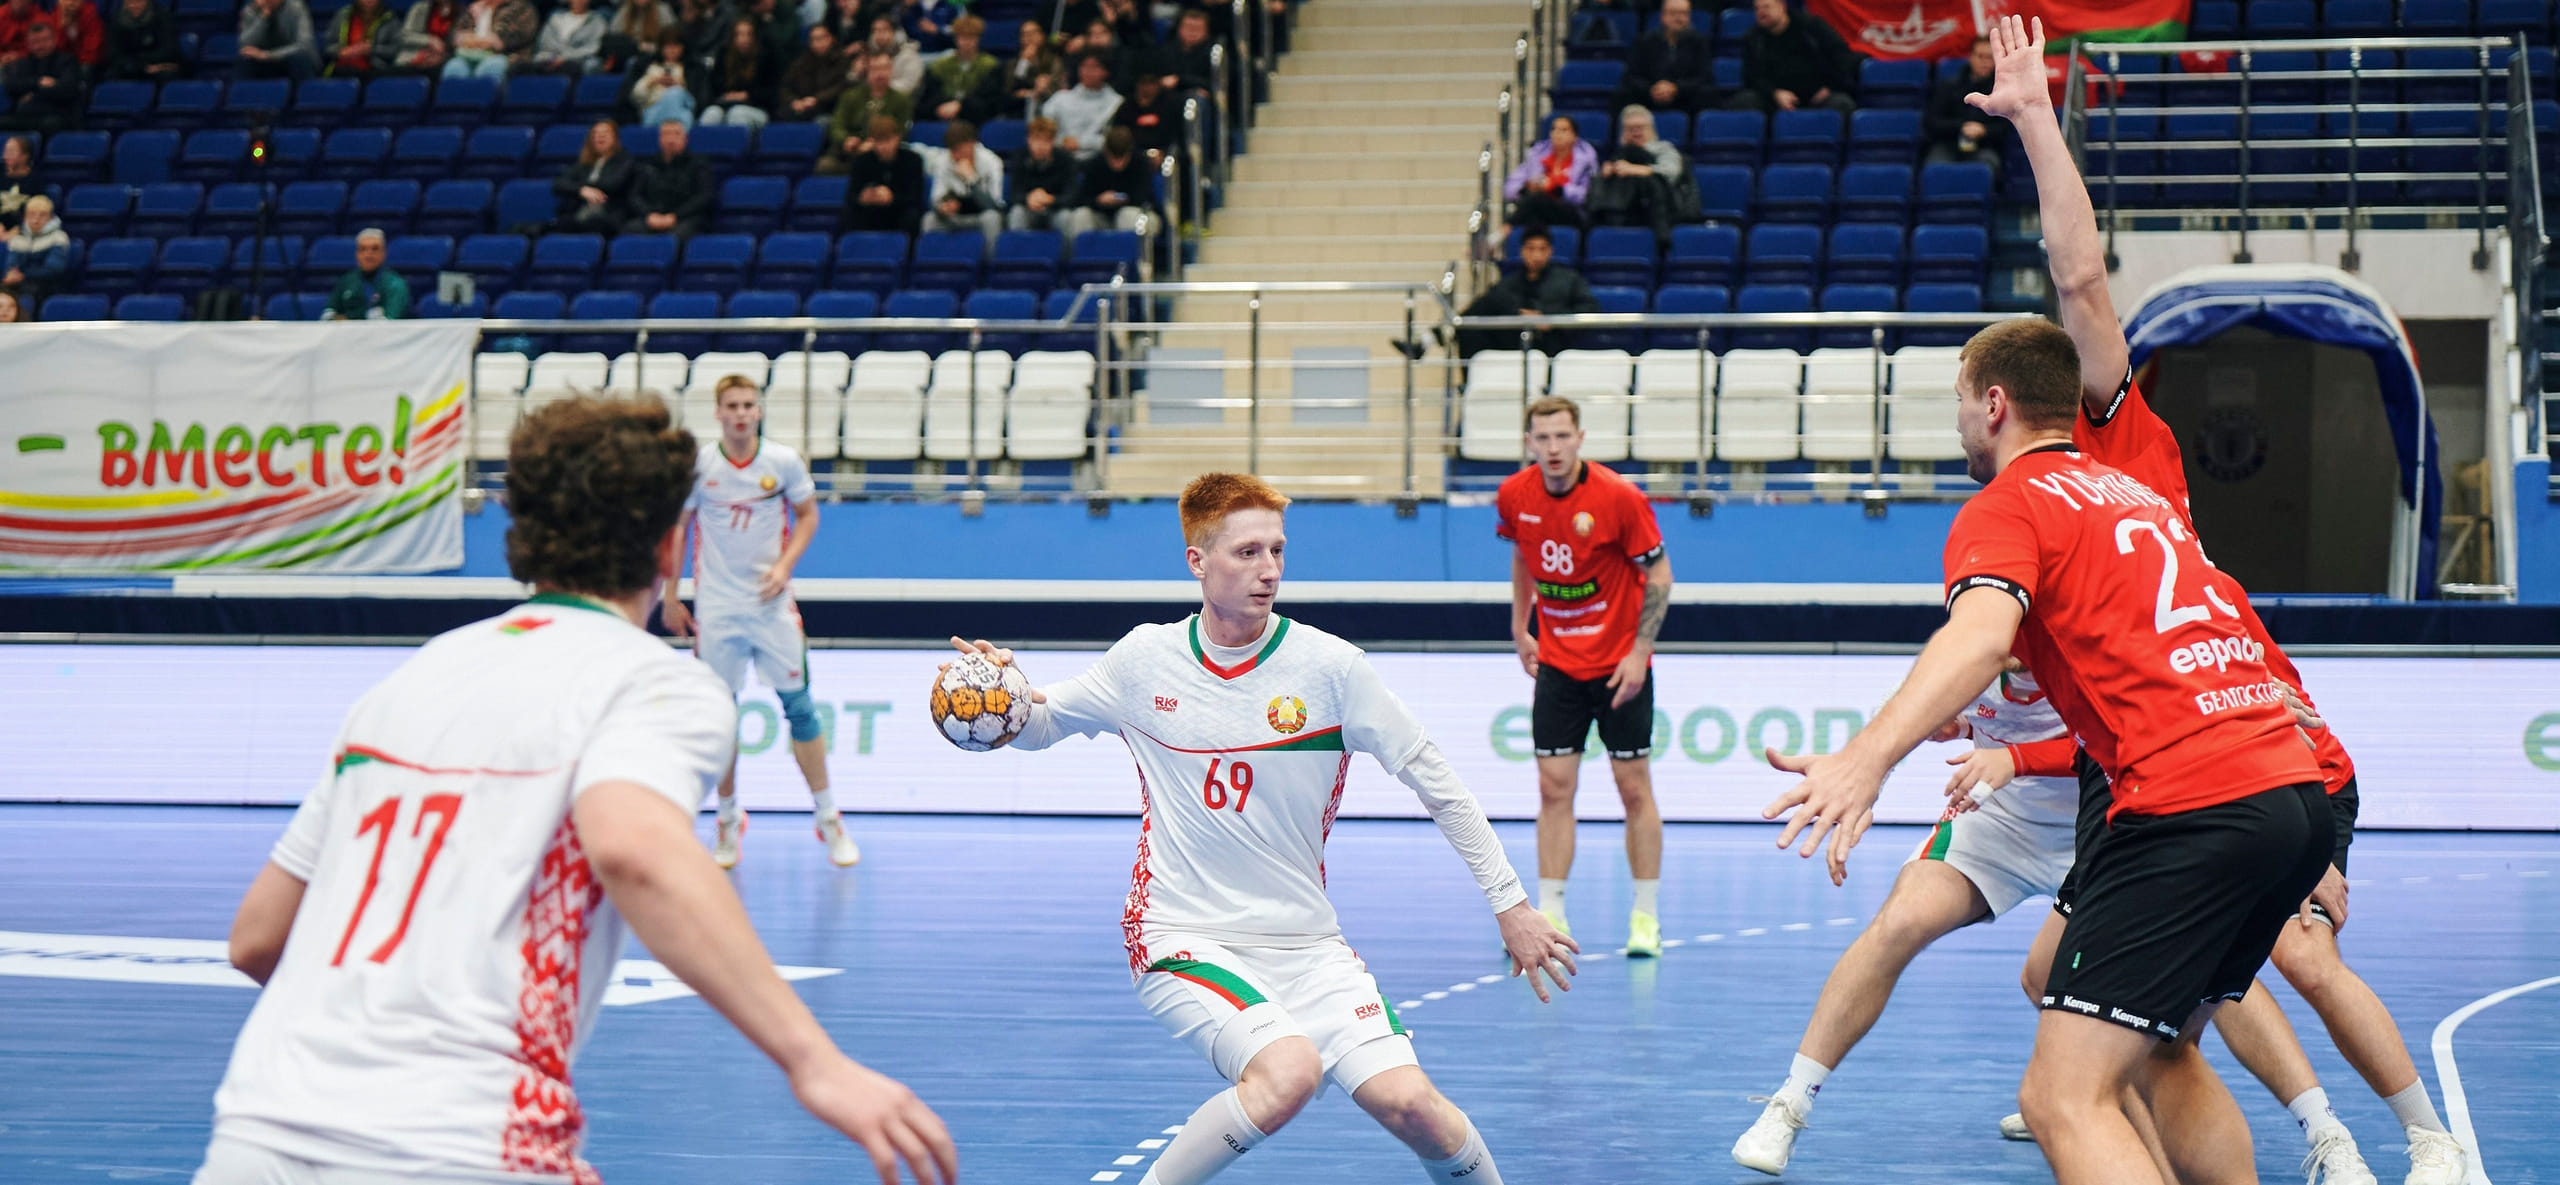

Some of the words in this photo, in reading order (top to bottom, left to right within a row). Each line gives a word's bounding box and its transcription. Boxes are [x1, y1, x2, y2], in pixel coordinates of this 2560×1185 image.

[730, 505, 753, 533] 77
[1540, 539, 1574, 576] 98
[1970, 576, 2009, 590] Kempa
[1203, 757, 1253, 813] 69
[329, 792, 464, 967] 17
[2063, 995, 2100, 1013] Kempa
[2111, 1007, 2150, 1028] Kempa
